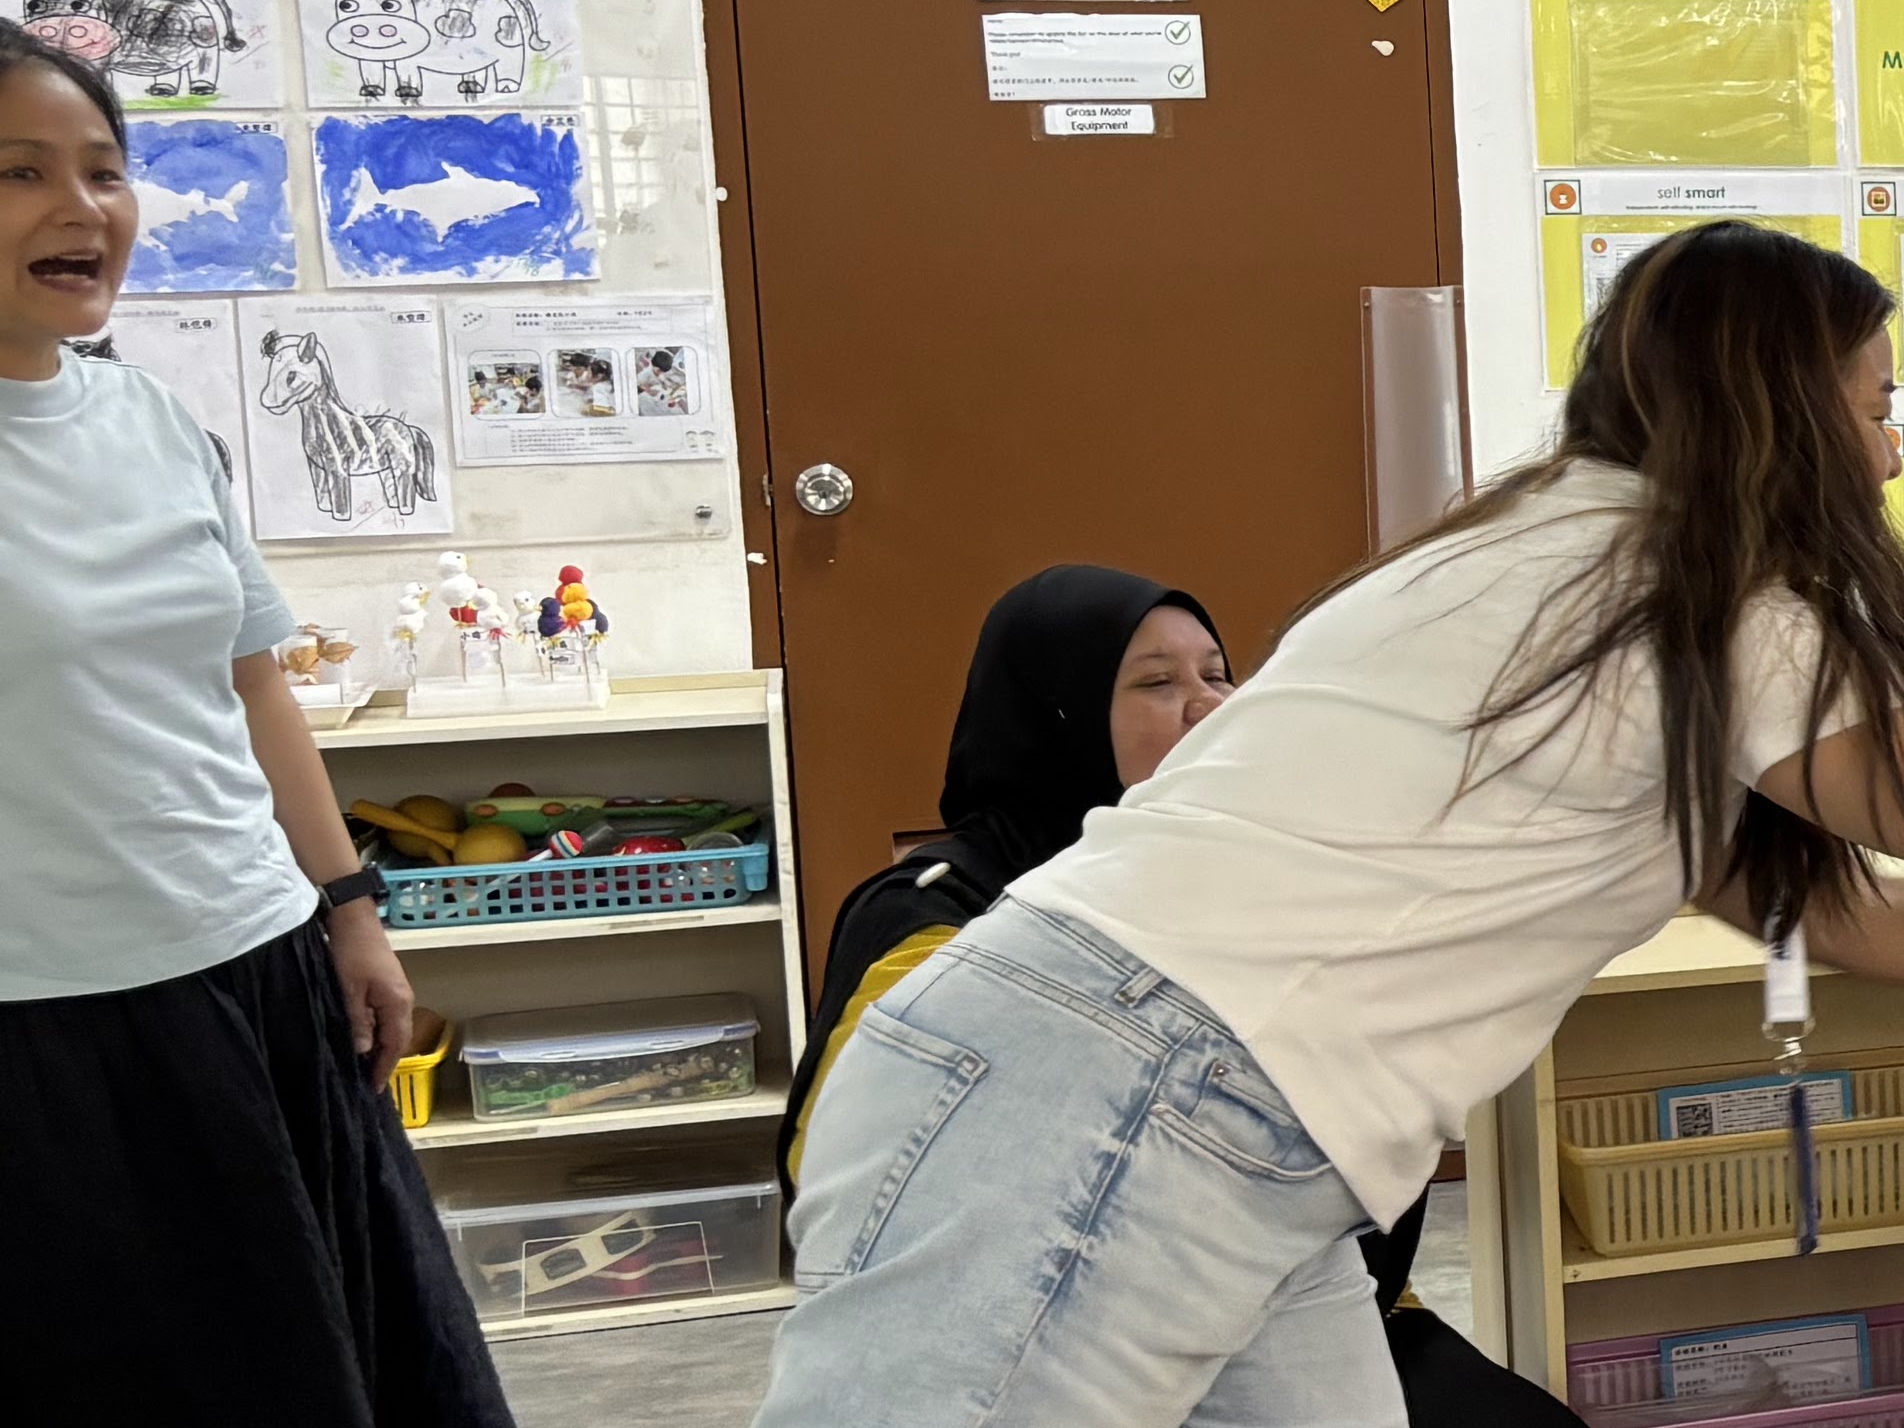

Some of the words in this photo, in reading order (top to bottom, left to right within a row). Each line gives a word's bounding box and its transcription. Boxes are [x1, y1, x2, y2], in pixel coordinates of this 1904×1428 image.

[1065, 106, 1097, 118] Gross
[1100, 106, 1132, 118] Motor
[1071, 120, 1129, 132] Equipment
[1657, 186, 1681, 199] self
[1684, 186, 1726, 200] smart
